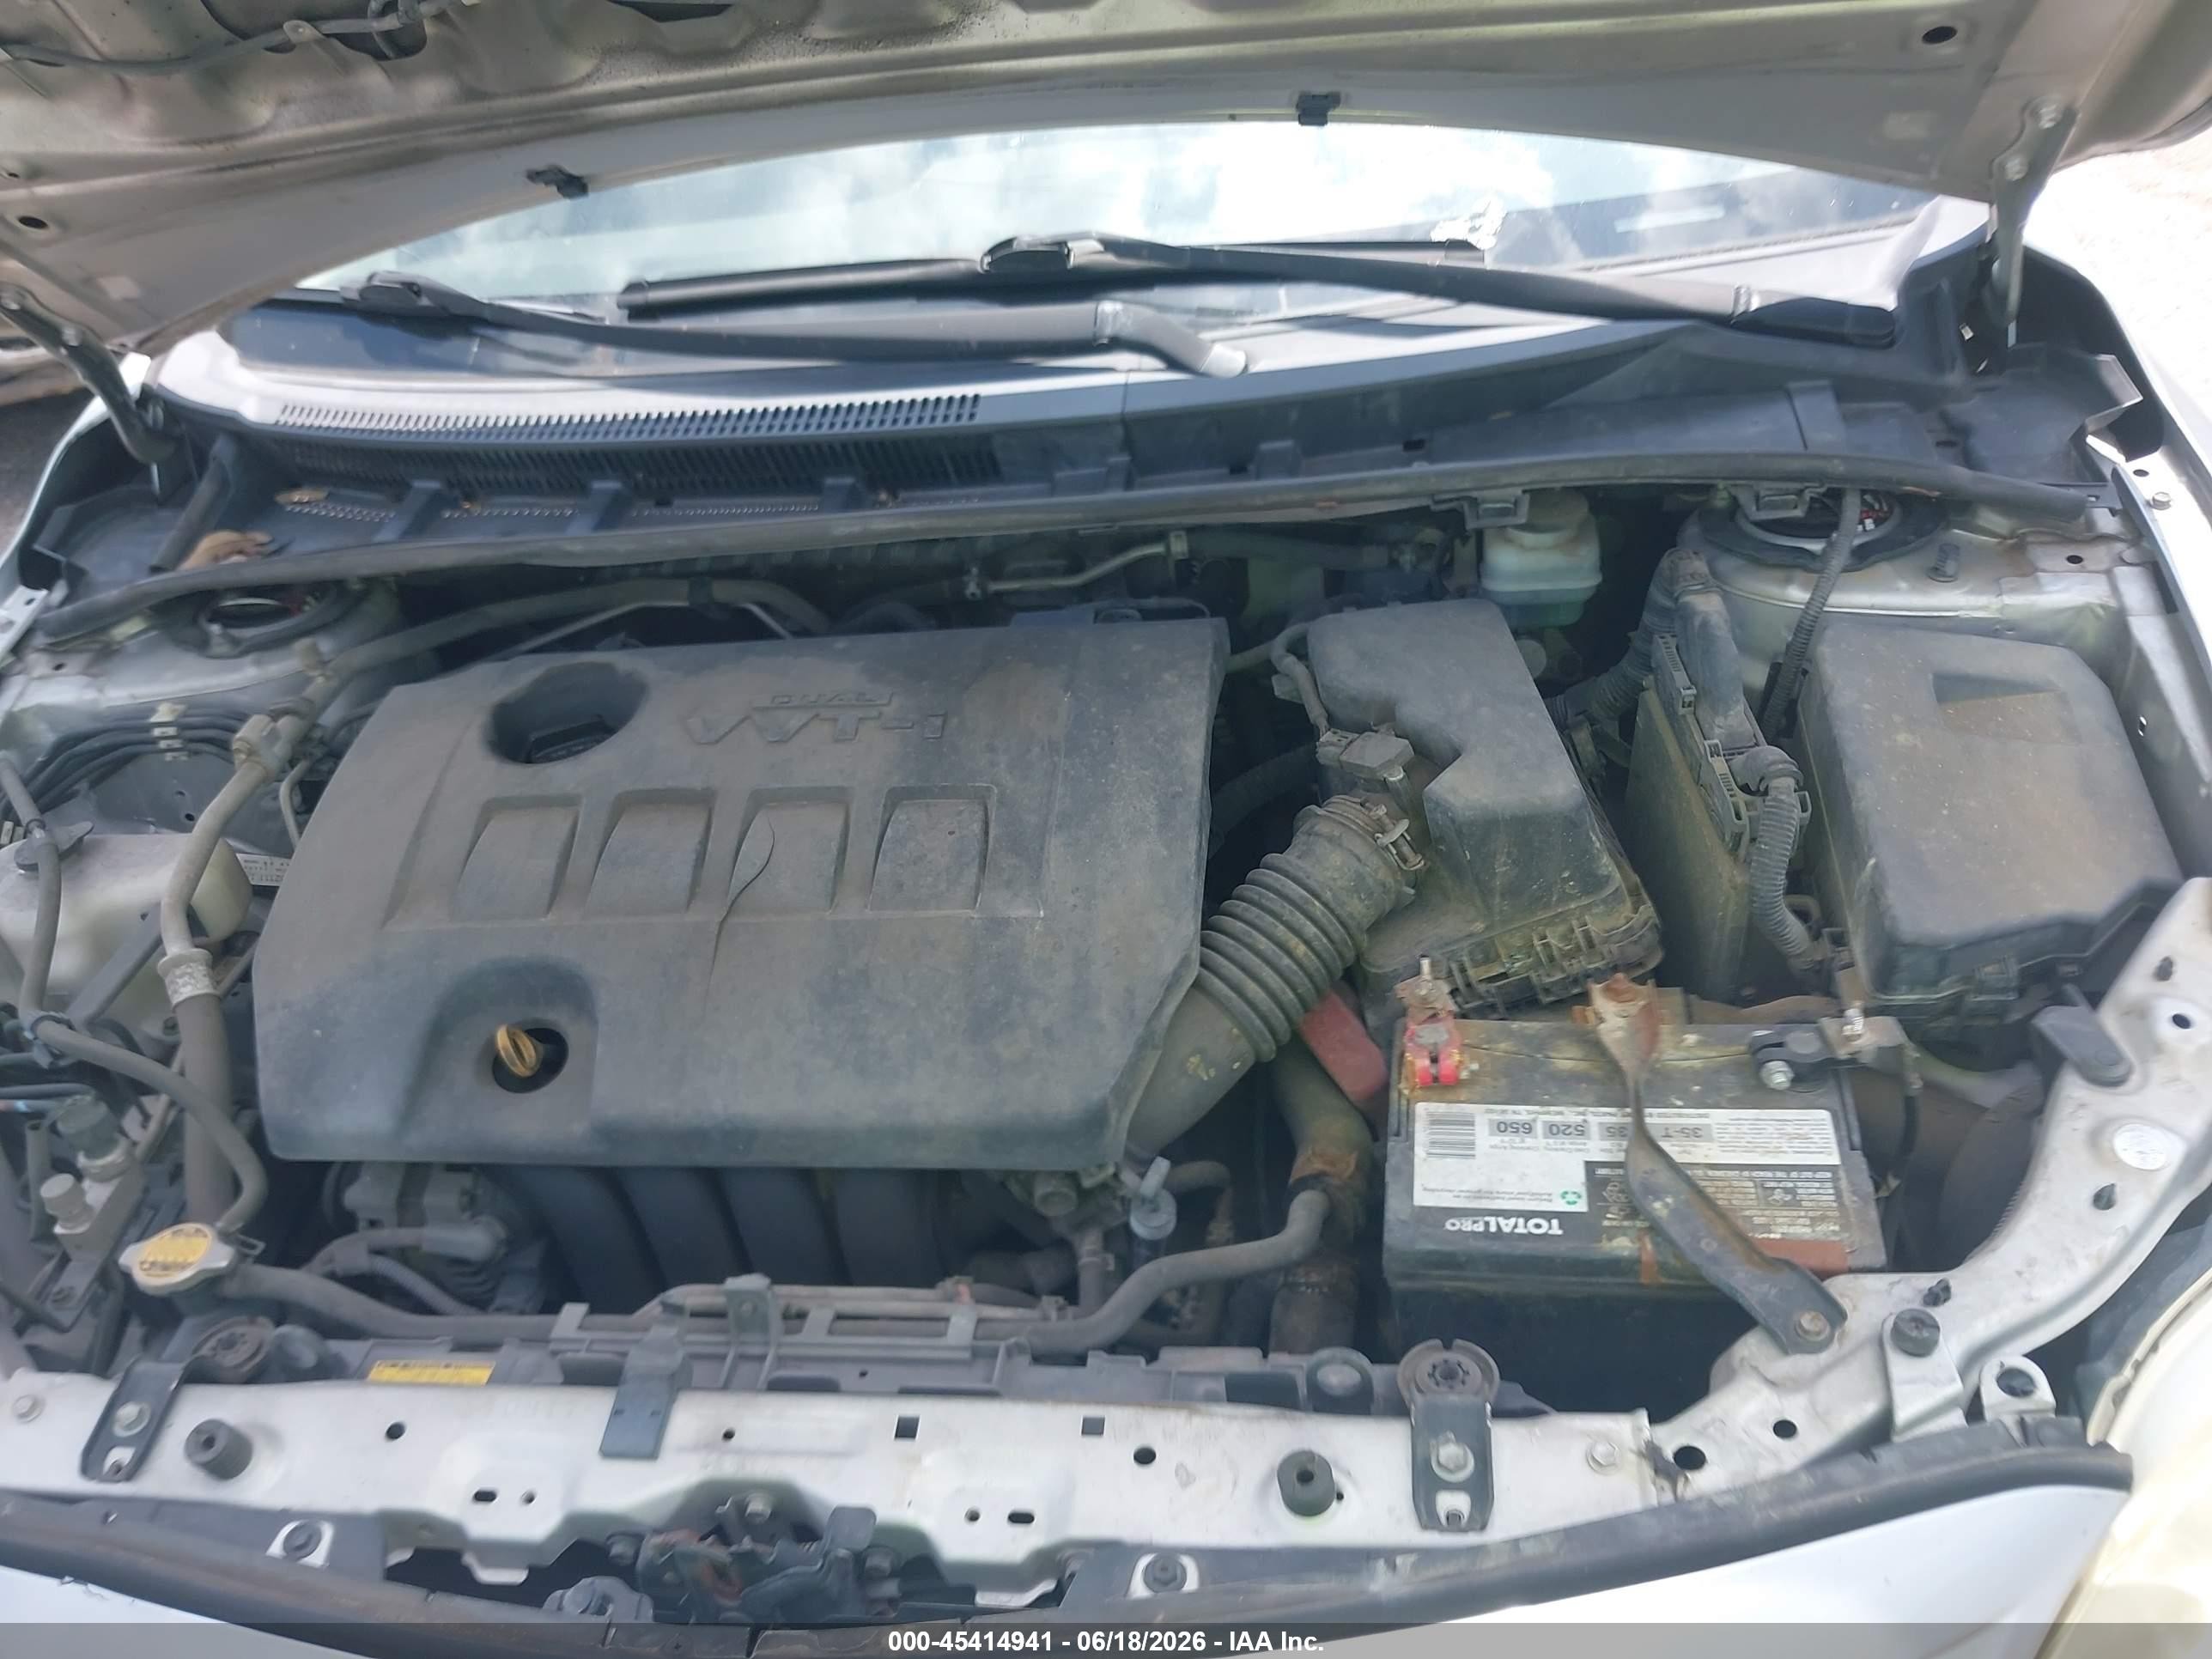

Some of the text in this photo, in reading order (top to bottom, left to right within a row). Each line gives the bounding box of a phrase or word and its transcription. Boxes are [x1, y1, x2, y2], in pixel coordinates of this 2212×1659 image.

[1497, 1121, 1533, 1135] 650
[1548, 1123, 1585, 1137] 520
[1606, 1126, 1628, 1138] 35
[1661, 1127, 1702, 1139] 35-T
[1444, 1216, 1563, 1235] TOTALPRO
